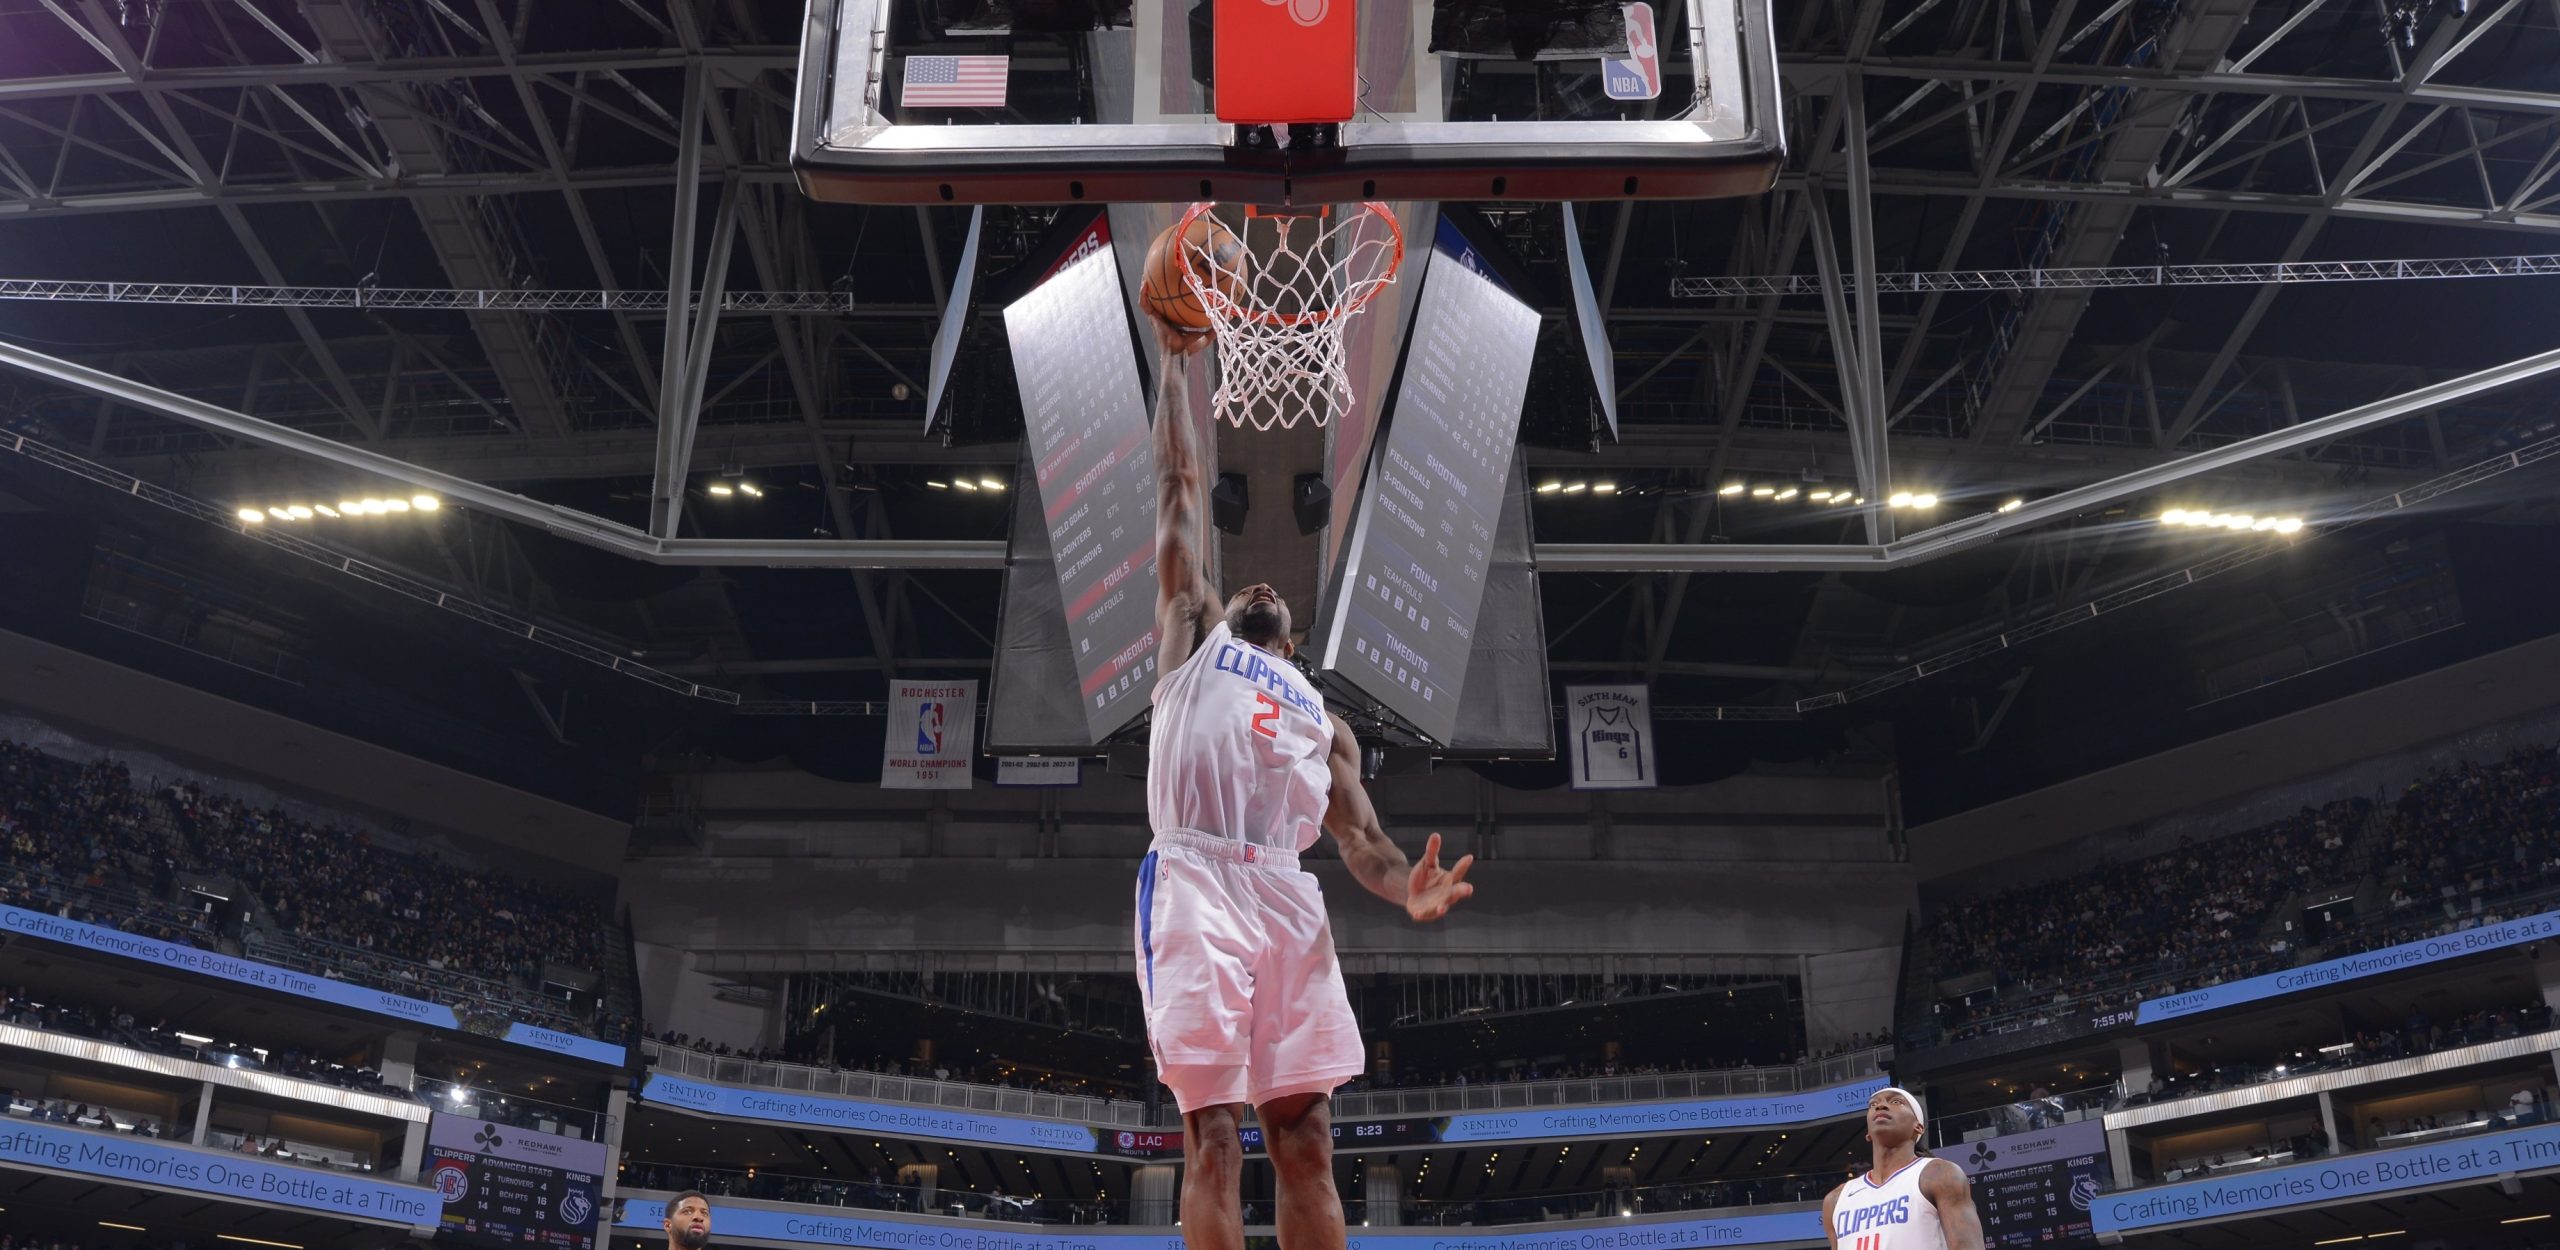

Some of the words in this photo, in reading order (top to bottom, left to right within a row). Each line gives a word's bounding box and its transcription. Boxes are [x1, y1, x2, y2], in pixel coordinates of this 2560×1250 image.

[1613, 77, 1639, 92] NBA
[1424, 356, 1455, 392] MITCHELL
[1420, 374, 1447, 404] BARNES
[1041, 411, 1061, 434] MANN
[1413, 393, 1429, 415] TEAM
[1428, 408, 1449, 432] TOTALS
[1044, 427, 1065, 451] ZUBAC
[1047, 455, 1062, 473] TEAM
[1061, 438, 1081, 459] TOTALS
[1075, 451, 1116, 495] SHOOTING
[1389, 448, 1409, 471] FIELD
[1408, 466, 1431, 490] GOALS
[1426, 453, 1468, 497] SHOOTING
[1384, 471, 1424, 511] 3-POINTERS
[1052, 523, 1069, 541] FIELD
[1069, 503, 1089, 526] GOALS
[1379, 493, 1396, 514] FREE
[1397, 508, 1426, 538] THROWS
[1056, 526, 1092, 562] 3-POINTERS
[1061, 564, 1077, 584] FREE
[1076, 544, 1102, 573] THROWS
[1103, 561, 1131, 590] FOULS
[1383, 565, 1402, 585] TEAM
[1401, 582, 1423, 603] FOULS
[1410, 563, 1438, 593] FOULS
[1086, 606, 1104, 625] TEAM
[1103, 590, 1124, 612] FOULS
[1447, 616, 1469, 639] BONUS
[1112, 632, 1154, 671] TIMEOUTS
[1385, 633, 1429, 674] TIMEOUTS
[901, 687, 966, 698] ROCHESTER
[1214, 643, 1323, 726] CLIPPERS
[1577, 692, 1610, 707] SIXTH
[1612, 692, 1638, 707] MAN
[1251, 691, 1280, 738] 2
[1591, 729, 1631, 745] Kings
[889, 758, 917, 768] WORLD
[920, 759, 967, 768] CHAMPIONS
[1618, 747, 1628, 759] 6
[916, 770, 940, 779] 1951
[5, 909, 74, 941] Crafting
[78, 926, 160, 959] Memories
[164, 946, 198, 967] One
[201, 954, 249, 979] Bottle
[250, 966, 266, 983] at
[268, 973, 277, 985] a
[280, 972, 318, 995] Time
[2276, 966, 2339, 990] Crafting
[2341, 947, 2422, 975] Memories
[2425, 940, 2461, 957] One
[2465, 925, 2518, 949] Bottle
[2521, 920, 2540, 938] at
[2542, 921, 2552, 933] a
[379, 994, 430, 1015] SENTIVO
[2159, 991, 2210, 1011] SENTIVO
[2091, 1014, 2116, 1028] 7:55
[2117, 1009, 2135, 1024] PM
[528, 1029, 574, 1047] SENTIVO
[661, 1081, 716, 1102] SENTIVO
[741, 1096, 797, 1117] Crafting
[799, 1102, 866, 1122] Memories
[868, 1109, 897, 1125] One
[900, 1112, 939, 1129] Bottle
[940, 1117, 953, 1130] at
[956, 1122, 964, 1131] a
[966, 1119, 999, 1135] Time
[1462, 1118, 1518, 1131] SENTIVO
[1543, 1114, 1596, 1129] Crafting
[1600, 1110, 1664, 1126] Memories
[1669, 1108, 1698, 1123] One
[1701, 1105, 1742, 1120] Bottle
[1744, 1105, 1758, 1118] at
[1761, 1107, 1769, 1117] a
[1771, 1102, 1805, 1116] Time
[1030, 1126, 1084, 1141] SENTIVO
[1138, 1135, 1163, 1146] LAC
[1239, 1131, 1258, 1142] AC
[1356, 1125, 1383, 1136] 6:23
[2010, 1137, 2057, 1152] REDHAWK
[433, 1147, 476, 1163] CLIPPERS
[517, 1138, 563, 1153] REDHAWK
[482, 1157, 527, 1173] ADVANCED
[528, 1165, 553, 1177] STATS
[1983, 1167, 2026, 1183] ADVANCED
[2027, 1164, 2054, 1176] STATS
[2067, 1156, 2094, 1168] KINGS
[0, 1132, 72, 1165] afting
[78, 1142, 200, 1181] Memories
[206, 1164, 255, 1190] One
[261, 1172, 328, 1201] Bottle
[332, 1188, 353, 1207] at
[358, 1194, 369, 1208] a
[376, 1191, 426, 1217] Time
[483, 1172, 490, 1182] 2
[498, 1175, 534, 1189] TURNOVERS
[540, 1183, 548, 1191] 4
[566, 1171, 591, 1183] KINGS
[2113, 1195, 2200, 1223] Crafting
[2202, 1177, 2315, 1209] Memories
[2319, 1169, 2371, 1190] One
[2376, 1153, 2451, 1183] Bottle
[2458, 1149, 2483, 1171] at
[2488, 1149, 2502, 1166] a
[2505, 1139, 2560, 1162] Tim
[481, 1187, 489, 1196] 11
[499, 1190, 513, 1200] BCH
[515, 1192, 529, 1202] PTS
[537, 1196, 547, 1206] 16
[1988, 1188, 1995, 1197] 2
[2001, 1181, 2038, 1194] TURNOVERS
[2044, 1179, 2052, 1187] 4
[478, 1201, 488, 1210] 14
[502, 1205, 521, 1215] DREB
[535, 1210, 545, 1220] 15
[1989, 1202, 1998, 1211] 11
[2006, 1198, 2021, 1208] BCH
[2022, 1196, 2036, 1206] PTS
[2044, 1193, 2055, 1202] 16
[1836, 1194, 1910, 1240] CLIPPERS
[1990, 1216, 2000, 1225] 14
[2014, 1211, 2033, 1221] DREB
[2046, 1207, 2058, 1217] 15
[786, 1218, 853, 1242] Crafting
[855, 1225, 936, 1248] Memories
[939, 1231, 973, 1249] One
[977, 1235, 1023, 1250] Bottle
[1026, 1240, 1041, 1250] at
[1046, 1242, 1054, 1250] a
[1501, 1237, 1577, 1250] Memories
[1581, 1234, 1615, 1249] One
[1619, 1227, 1667, 1247] Bottle
[1670, 1228, 1687, 1242] at
[1690, 1230, 1699, 1242] a
[1702, 1224, 1743, 1241] Time
